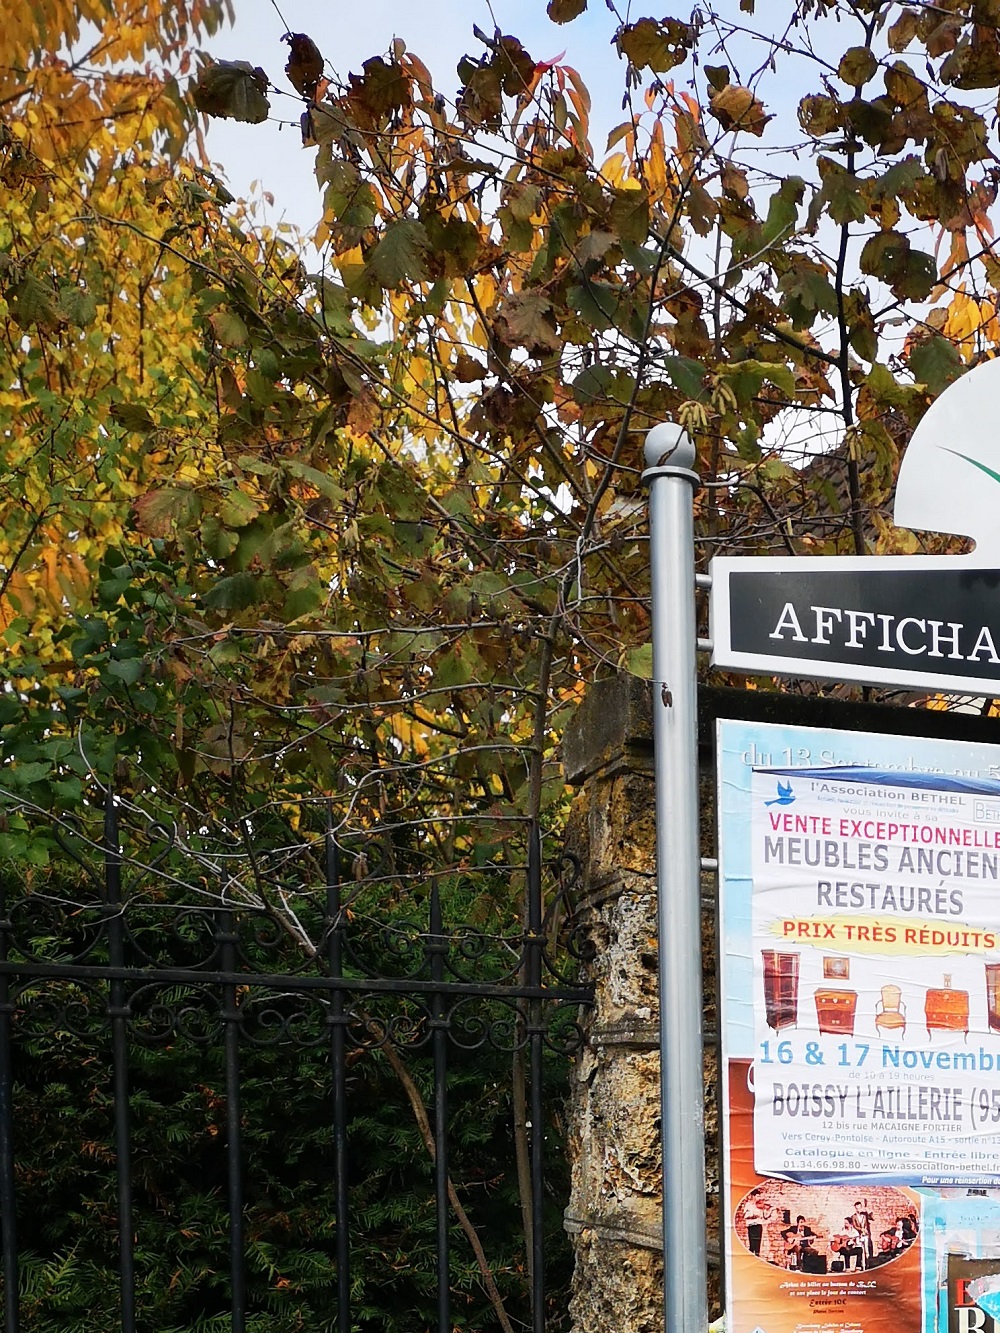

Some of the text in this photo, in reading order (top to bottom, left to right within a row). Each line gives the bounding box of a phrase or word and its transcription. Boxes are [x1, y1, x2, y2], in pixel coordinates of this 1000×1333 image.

[742, 743, 773, 767] du
[782, 748, 812, 766] 13
[988, 764, 1000, 781] 5
[811, 782, 967, 806] l'Association BETHEL
[769, 812, 832, 836] VENTE
[843, 807, 938, 822] vous invite à sa
[764, 835, 889, 872] MEUBLES
[817, 880, 964, 916] RESTAURÉS
[783, 920, 996, 948] PRIX TRÈS RÉDUITS
[760, 1040, 793, 1064] 16
[805, 1042, 825, 1065] &
[837, 1044, 870, 1067] 17
[772, 1082, 849, 1118] BOISSY
[856, 1084, 963, 1121] L'AILLERIE
[822, 1121, 833, 1129] 12
[836, 1121, 850, 1130] bis
[871, 1122, 919, 1131] MACAIGNE
[922, 1123, 962, 1132] FORTIER
[783, 1160, 861, 1169] 01.34.66.98.80
[785, 1148, 1000, 1160] Catalogue en ligne Entrée libre
